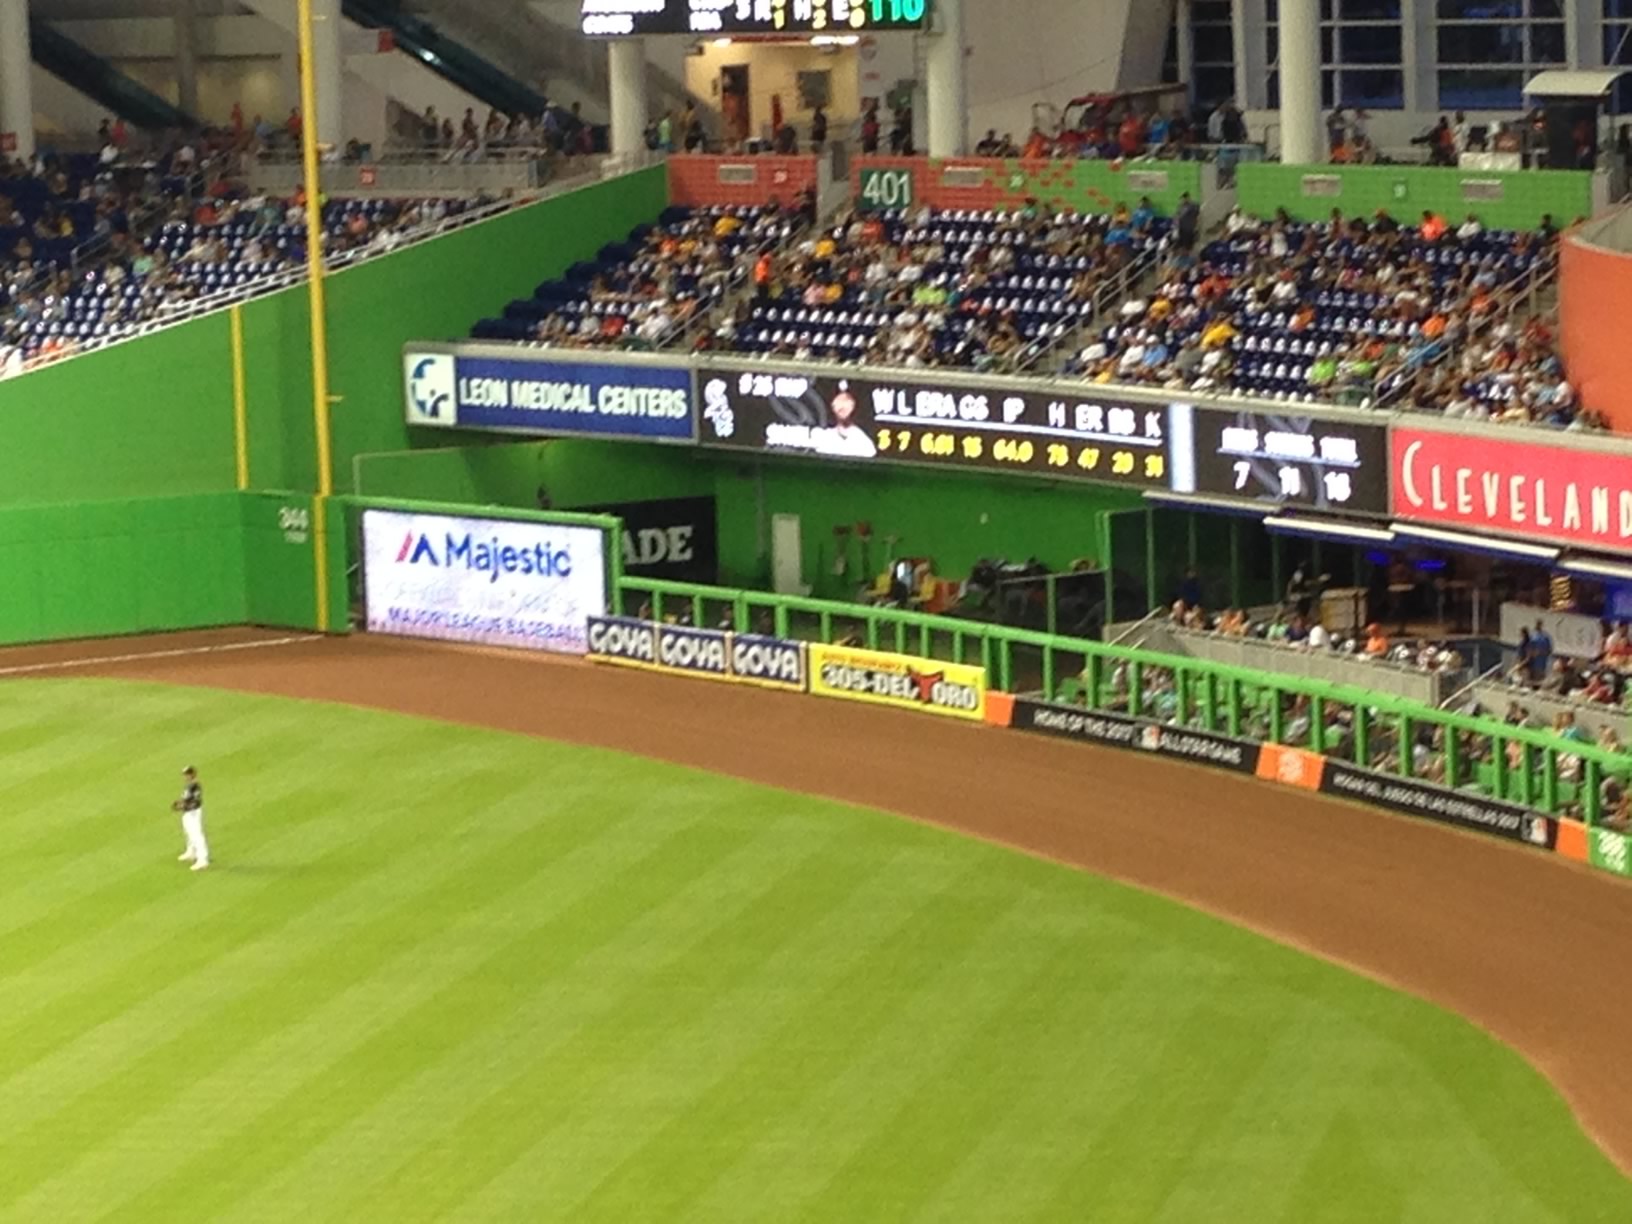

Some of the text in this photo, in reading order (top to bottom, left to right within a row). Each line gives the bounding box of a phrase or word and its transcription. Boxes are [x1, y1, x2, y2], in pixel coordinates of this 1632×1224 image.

[863, 171, 911, 205] 401
[459, 378, 687, 420] LEON MEDICAL CENTERS
[872, 388, 895, 414] W
[897, 390, 912, 415] L
[1049, 402, 1066, 428] H
[1144, 411, 1162, 438] K
[1233, 461, 1250, 490] 7
[445, 532, 572, 583] Majestic
[589, 622, 655, 660] GOYA
[661, 633, 726, 670] GOYA
[734, 641, 798, 680] GOYA
